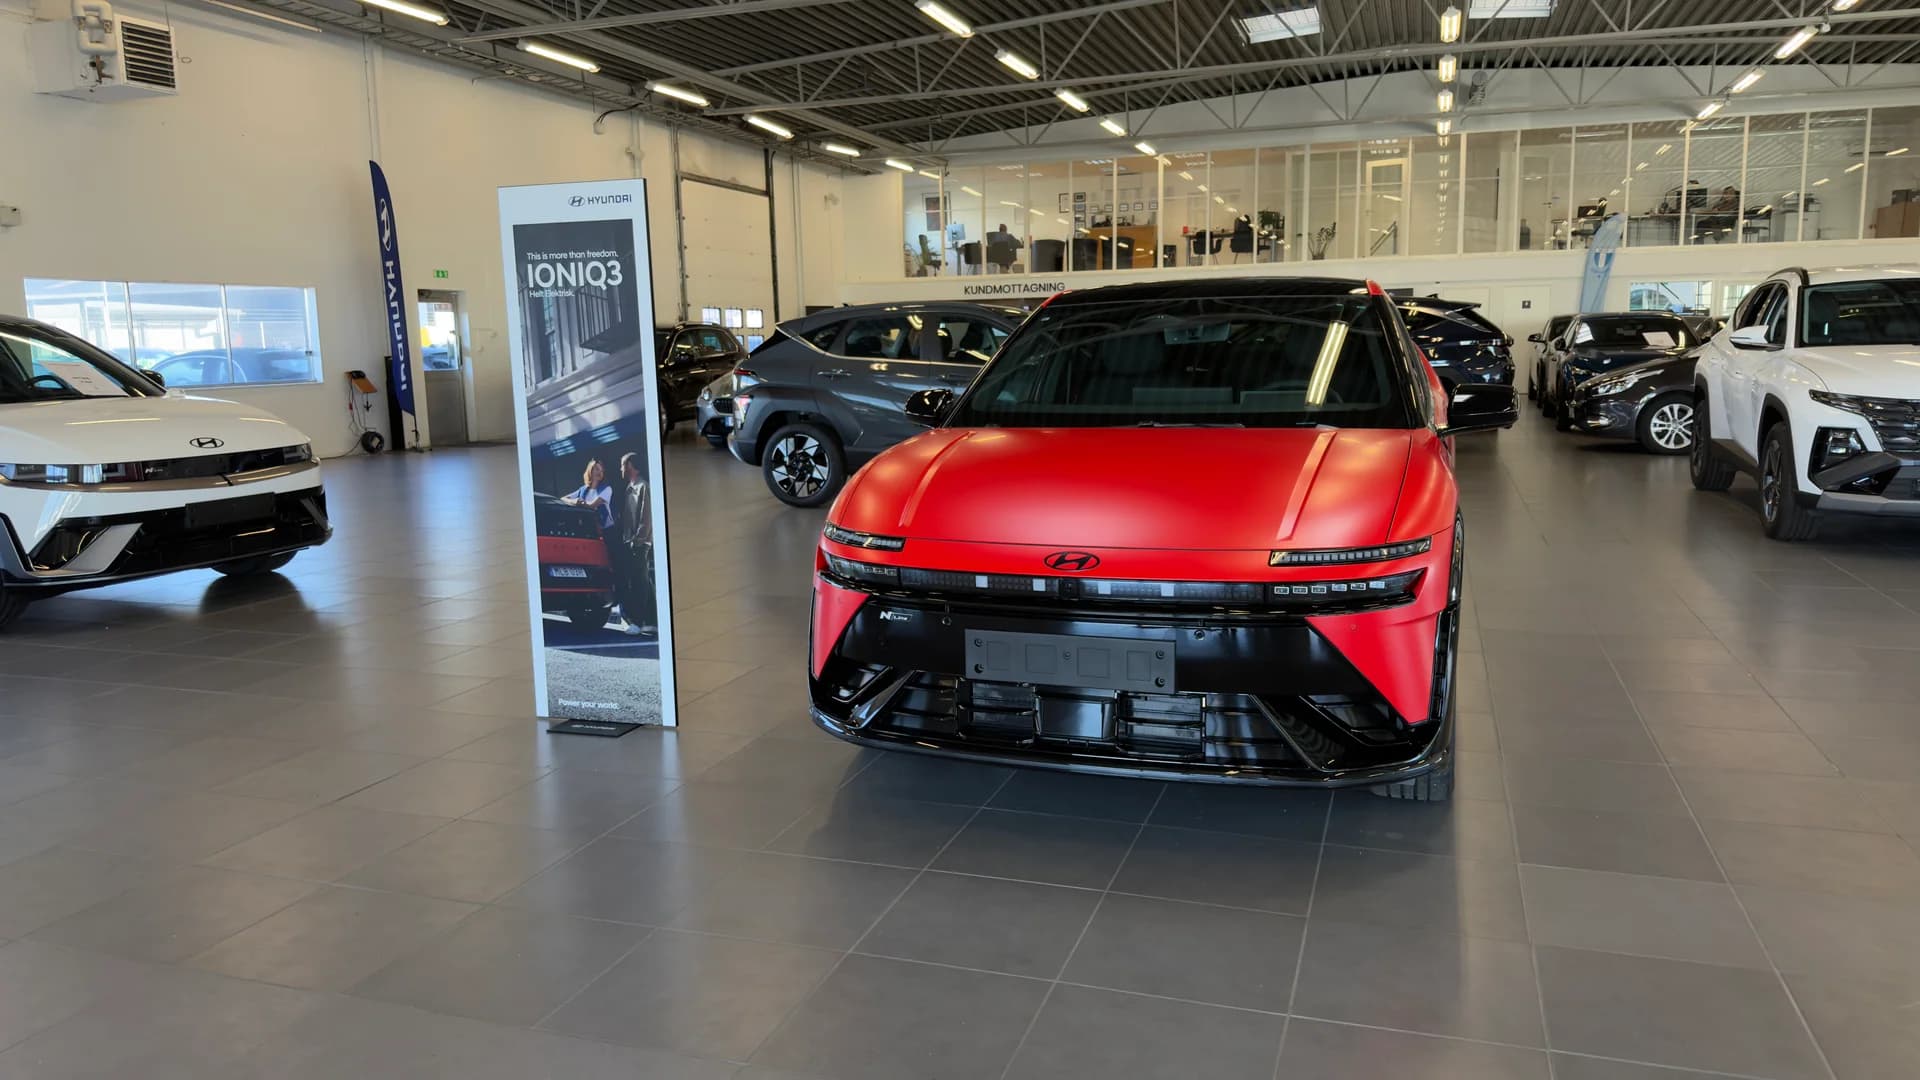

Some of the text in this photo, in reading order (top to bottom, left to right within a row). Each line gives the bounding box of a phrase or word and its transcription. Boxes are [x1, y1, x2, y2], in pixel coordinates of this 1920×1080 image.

[587, 193, 632, 205] HYUNDAI
[527, 252, 541, 260] This
[569, 250, 585, 259] than
[586, 249, 618, 258] freedom.
[527, 260, 623, 290] IONIQ3
[529, 290, 544, 298] Helt
[964, 282, 1066, 295] KUNDMOTTAGNING
[558, 698, 580, 706] Power
[581, 700, 596, 708] your
